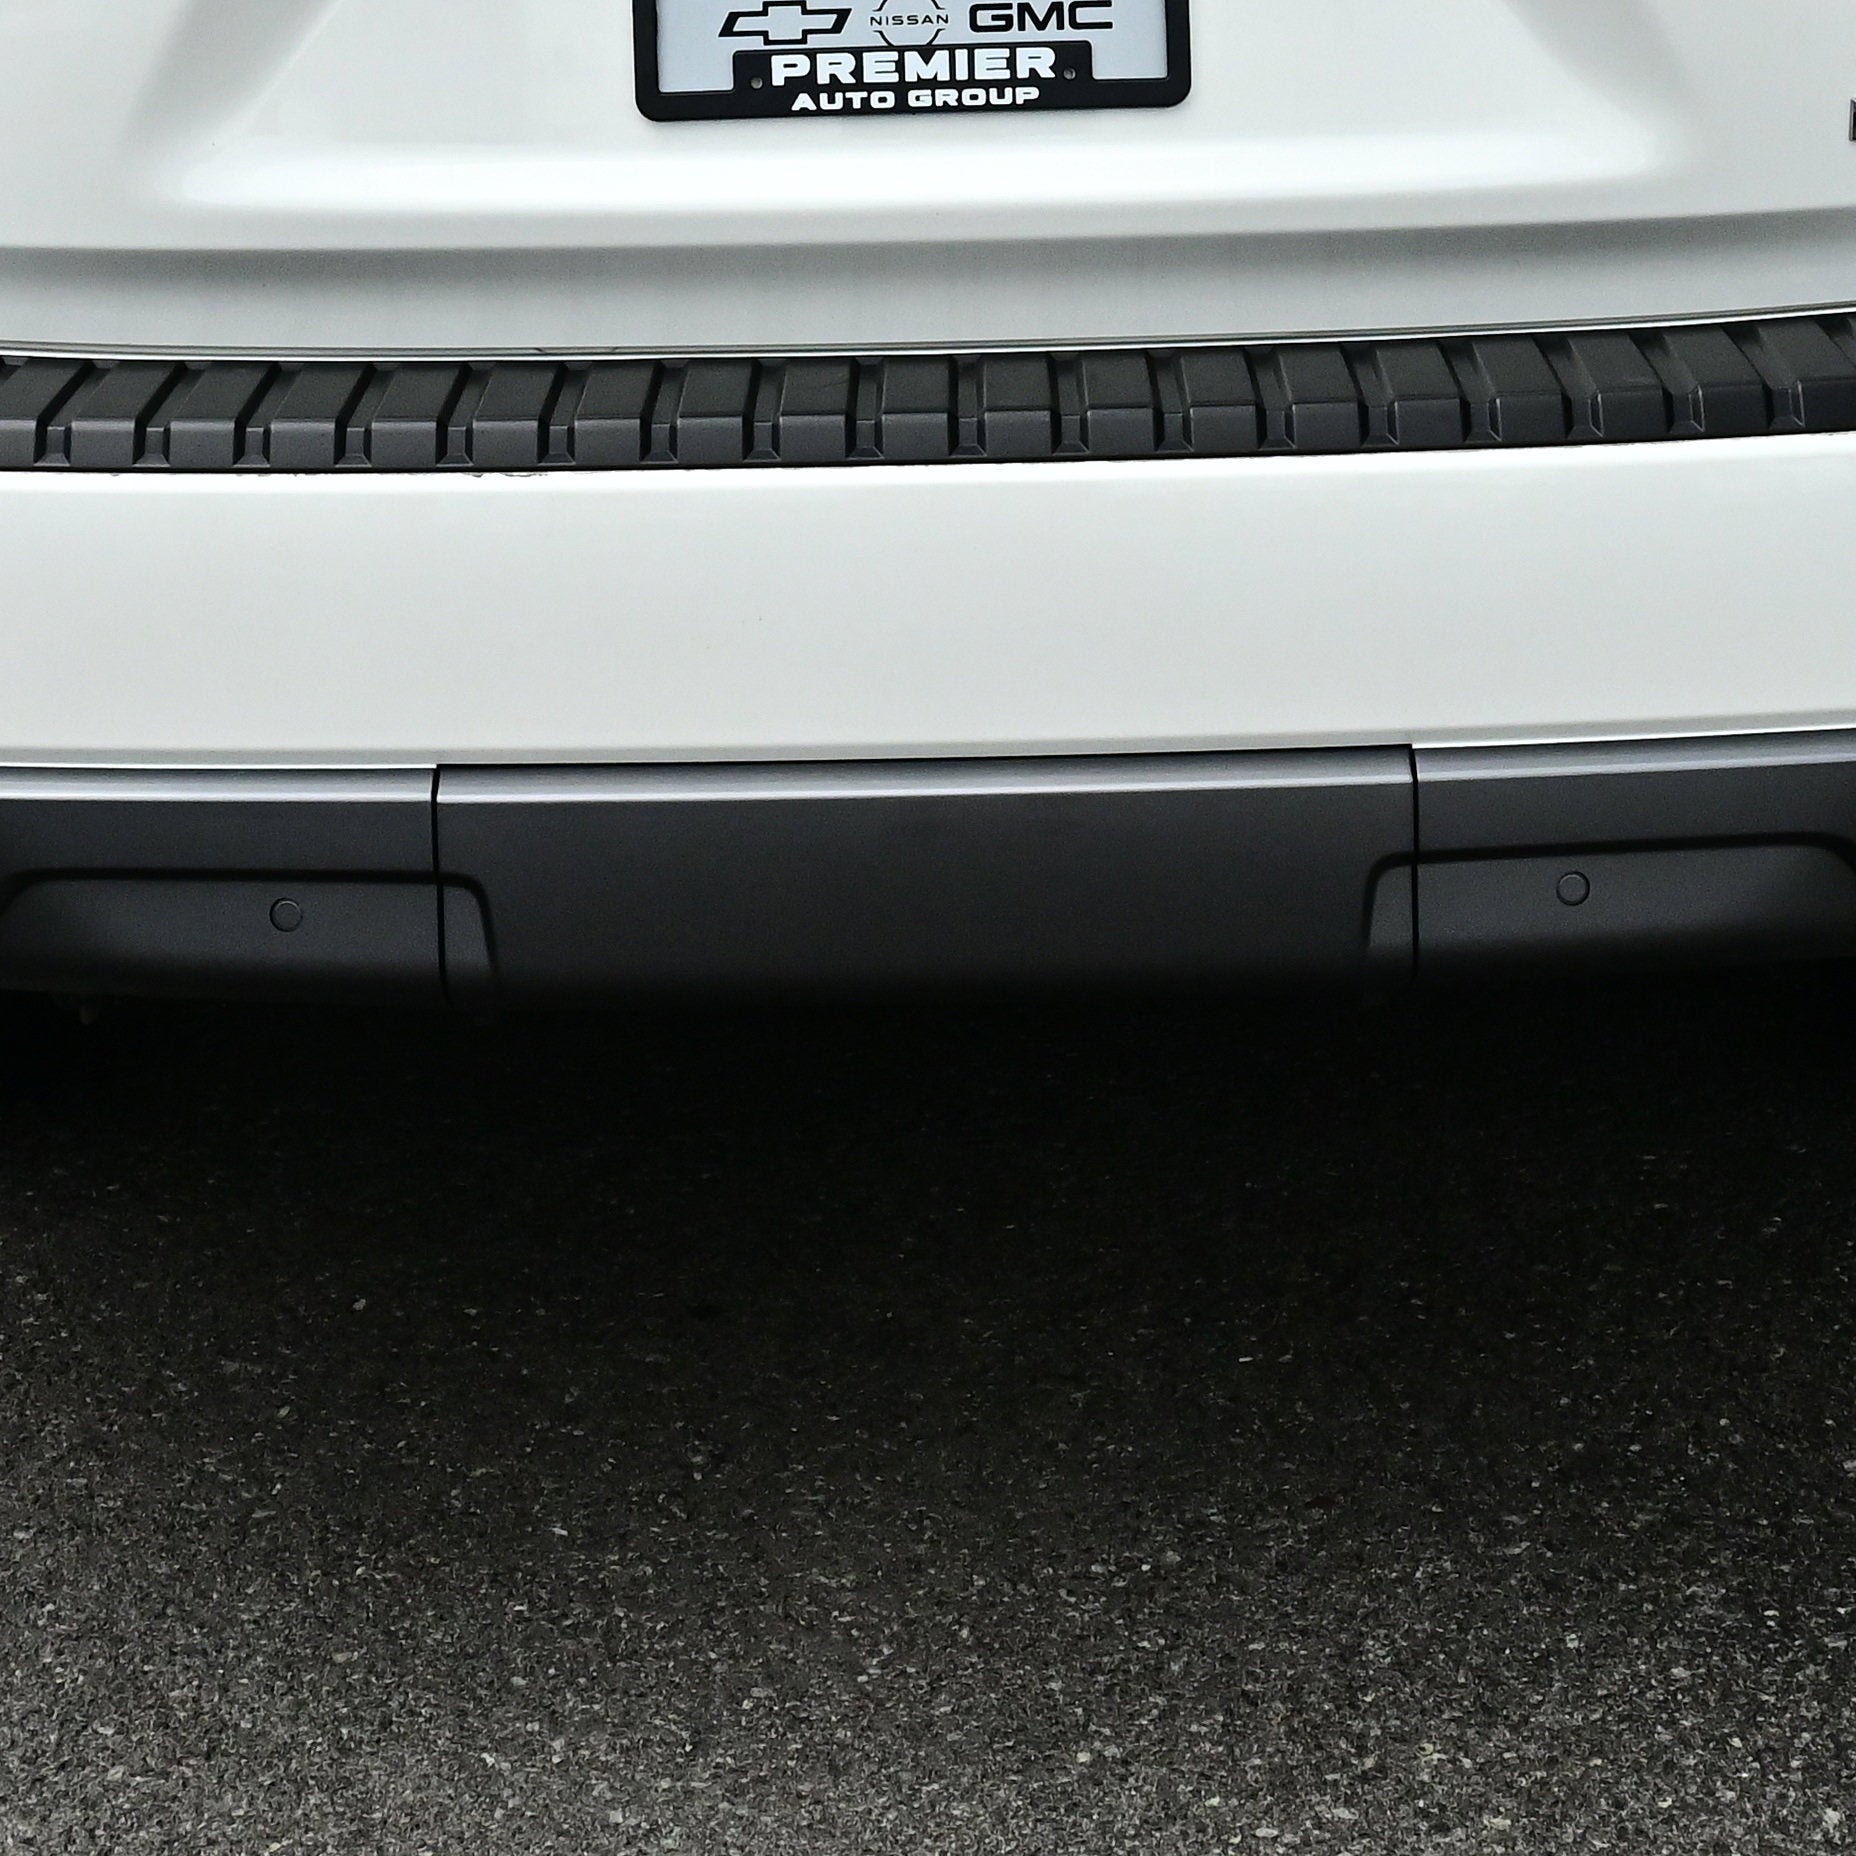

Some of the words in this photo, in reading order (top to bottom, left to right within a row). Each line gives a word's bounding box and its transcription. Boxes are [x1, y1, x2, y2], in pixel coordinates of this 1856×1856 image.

[870, 12, 949, 27] NISSAN
[968, 0, 1114, 33] GMC
[770, 47, 1056, 87] PREMIER
[790, 90, 896, 112] AUTO
[907, 86, 1040, 107] GROUP
